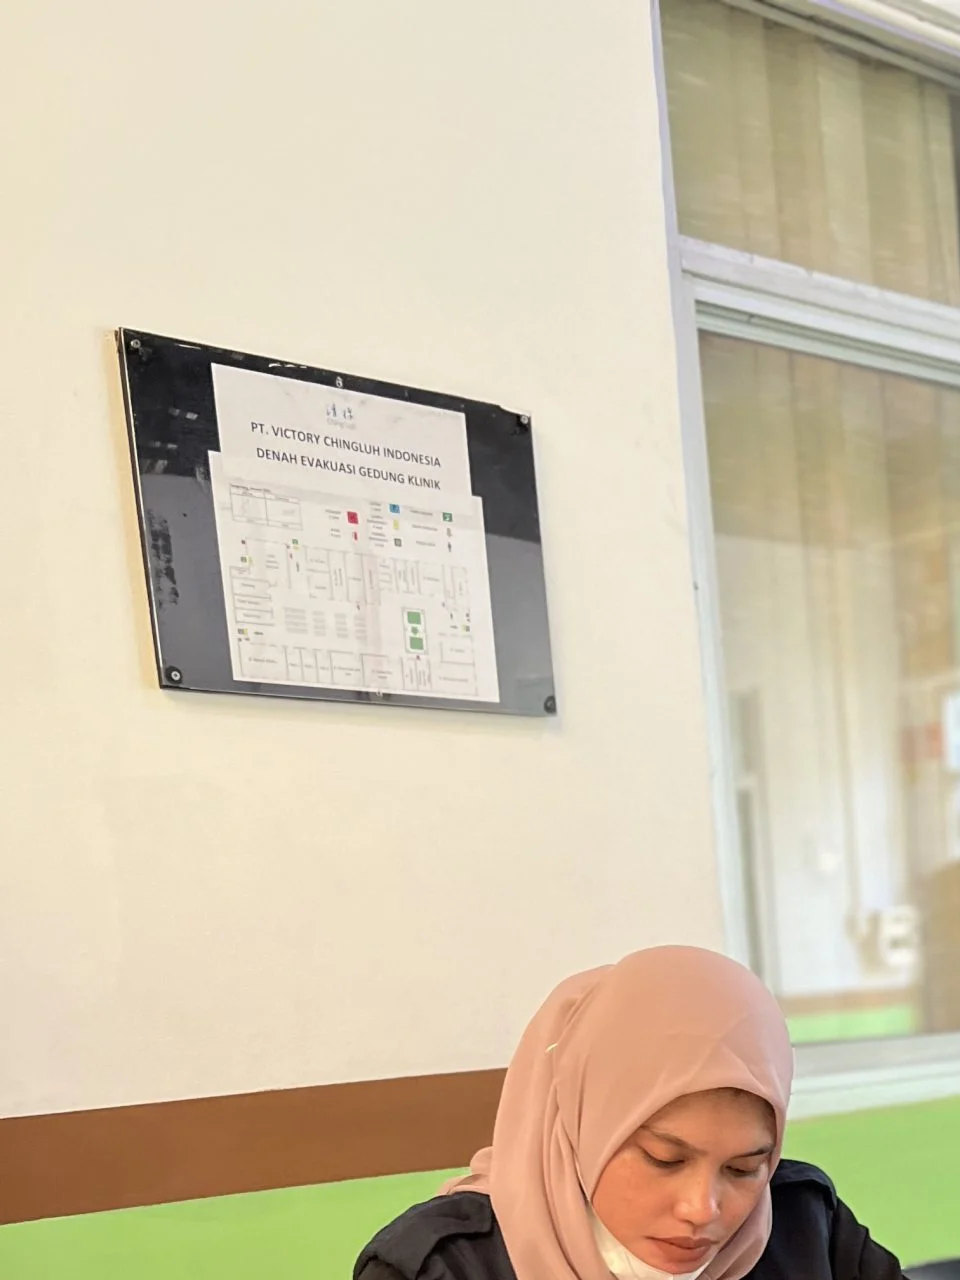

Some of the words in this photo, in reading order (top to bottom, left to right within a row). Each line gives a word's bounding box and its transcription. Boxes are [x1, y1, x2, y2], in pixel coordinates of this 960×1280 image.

[251, 421, 269, 435] PT.
[271, 426, 321, 444] VICTORY
[324, 436, 380, 456] CHINGLUH
[383, 448, 441, 467] INDONESIA
[256, 448, 298, 464] DENAH
[301, 456, 356, 475] EVAKUASI
[359, 466, 405, 484] GEDUNG
[408, 475, 441, 490] KLINIK
